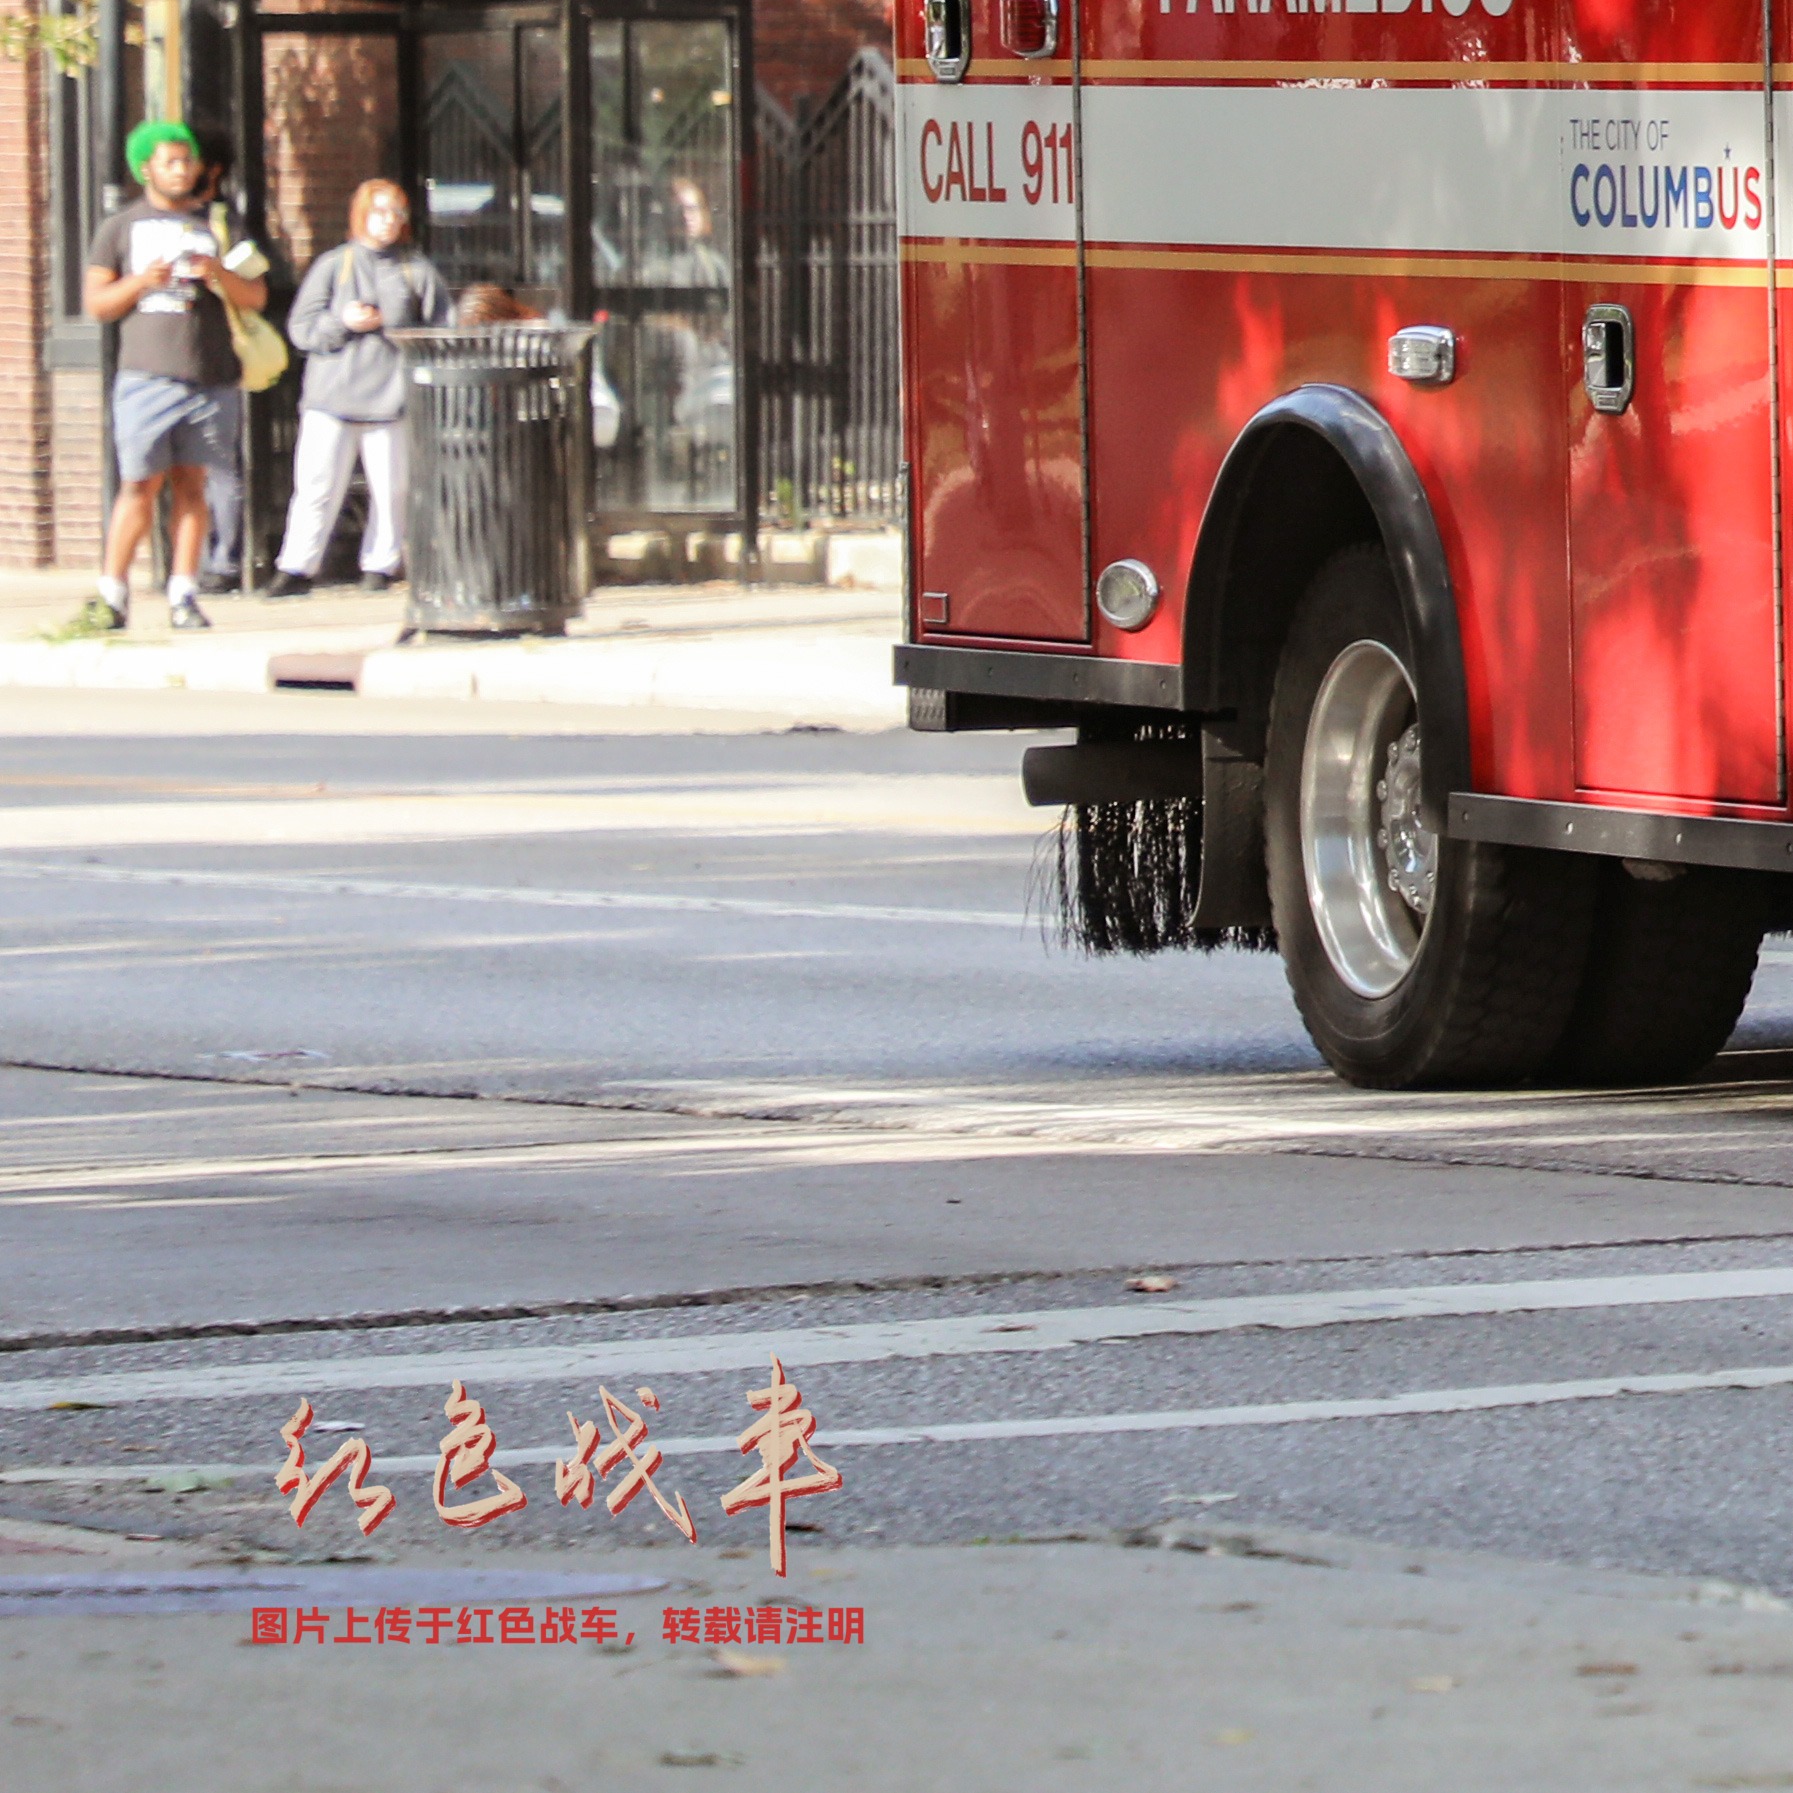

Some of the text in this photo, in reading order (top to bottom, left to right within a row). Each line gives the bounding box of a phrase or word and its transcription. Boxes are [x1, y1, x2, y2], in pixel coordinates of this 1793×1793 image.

[920, 119, 1075, 206] CALL 911
[1569, 118, 1670, 152] THE CITY OF
[1569, 164, 1763, 230] COLUMBUS
